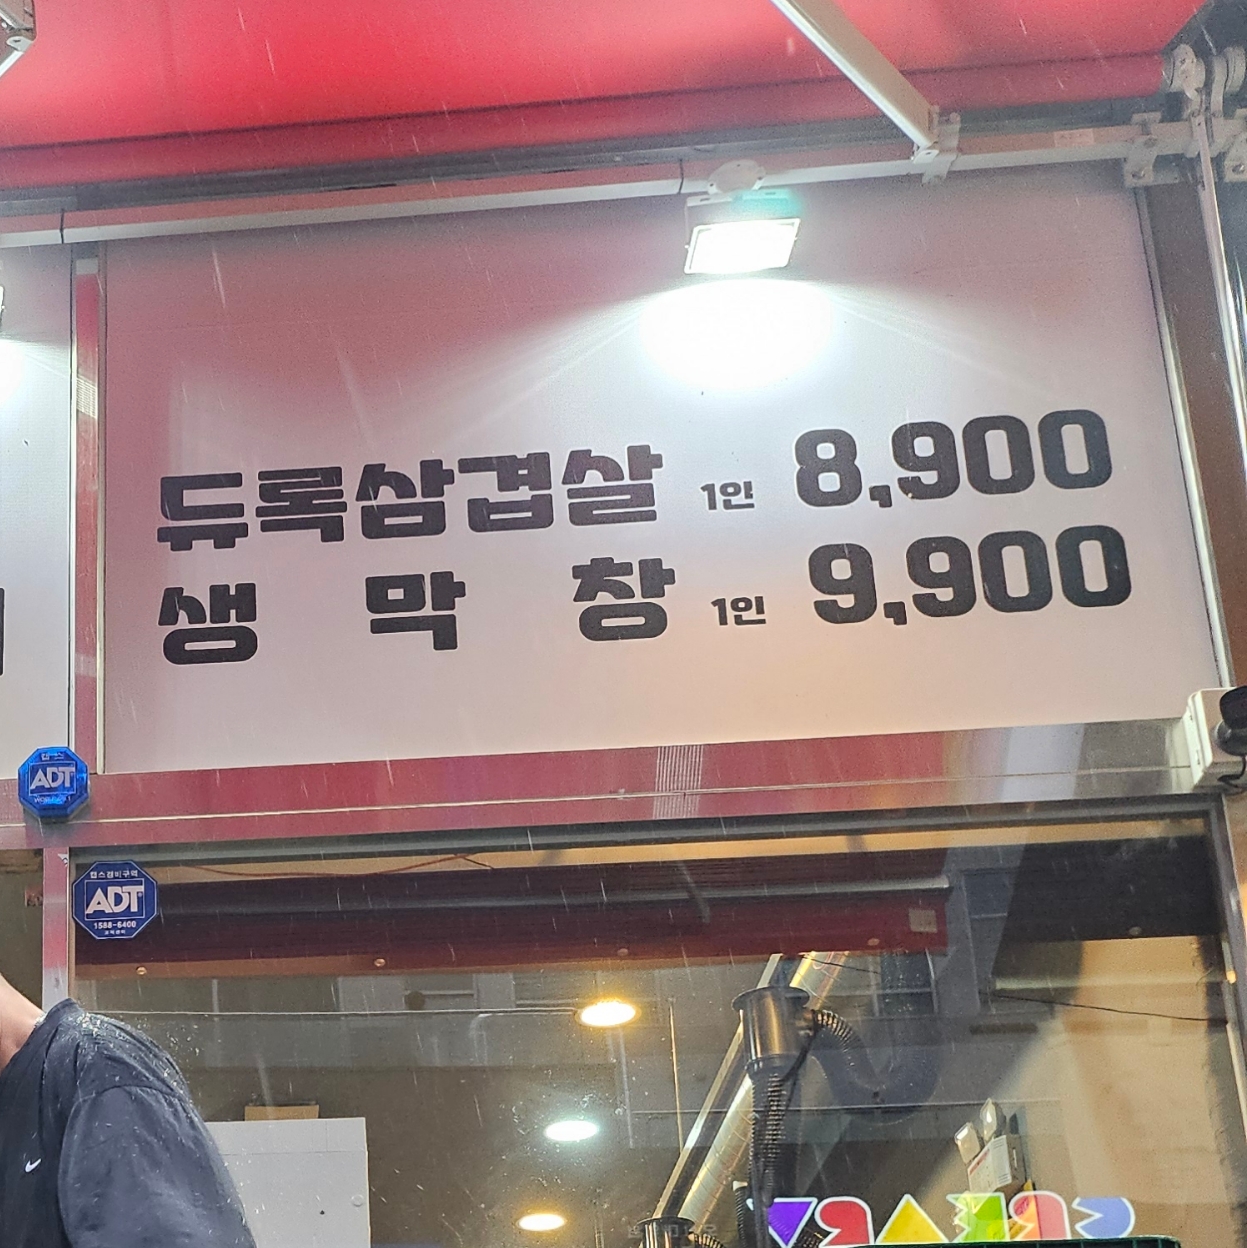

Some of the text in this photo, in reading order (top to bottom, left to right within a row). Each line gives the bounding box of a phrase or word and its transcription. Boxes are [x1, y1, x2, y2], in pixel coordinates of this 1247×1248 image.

[156, 409, 1113, 552] 듀록삼겹살 1인 8,900
[710, 596, 767, 626] 1인
[808, 525, 1132, 625] 9,900
[30, 767, 76, 790] ADT
[85, 885, 145, 915] ADT
[93, 920, 137, 930] 1588-6400
